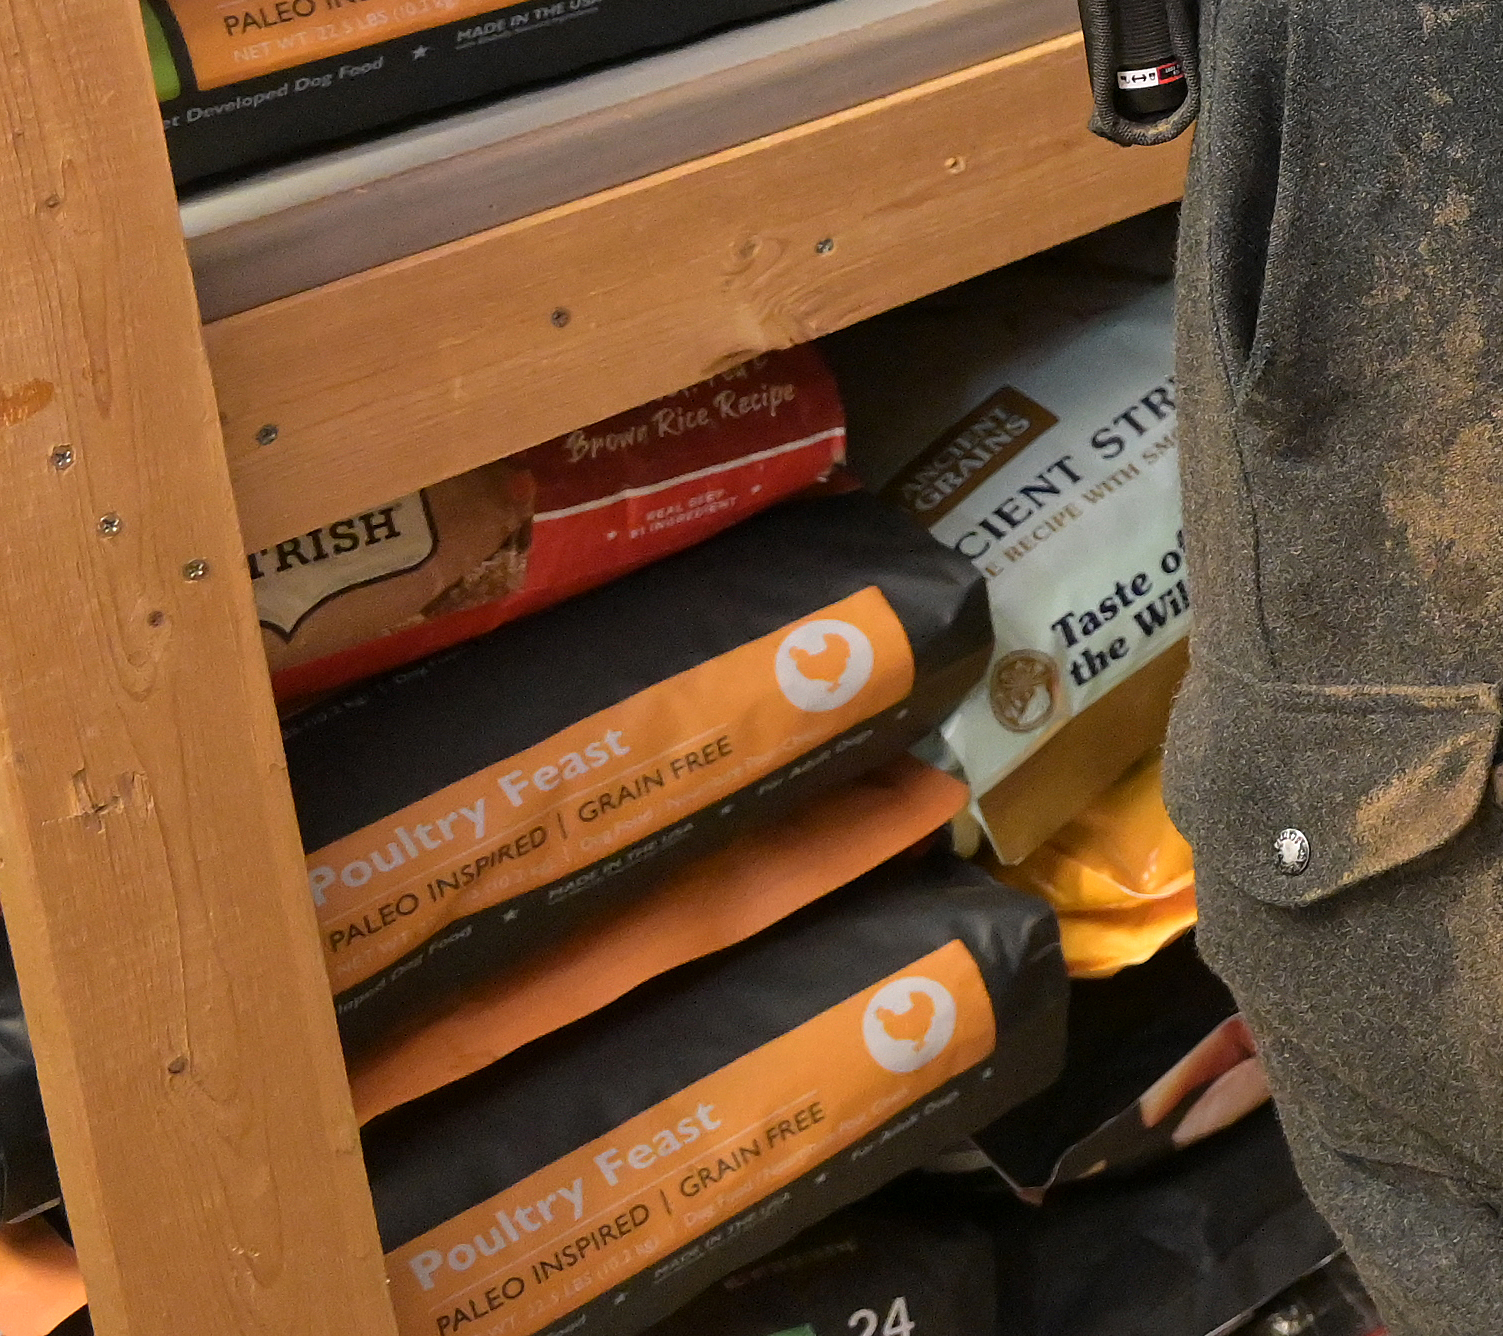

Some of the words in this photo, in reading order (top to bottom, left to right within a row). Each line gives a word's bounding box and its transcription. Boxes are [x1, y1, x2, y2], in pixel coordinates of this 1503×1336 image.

[185, 82, 289, 124] Developed
[293, 71, 334, 92] Dog
[338, 55, 385, 80] Food
[657, 409, 710, 439] Rice
[716, 379, 797, 422] Recipe
[1090, 374, 1177, 460] STR
[914, 413, 1032, 512] GRAINS
[1002, 503, 1084, 563] RECIPE
[1081, 462, 1141, 505] WITH
[1050, 569, 1154, 649] Taste
[1068, 636, 1130, 687] the
[307, 797, 486, 908] Poultry
[496, 728, 632, 808] Feast
[326, 892, 421, 954] PALEO
[426, 824, 548, 903] INSPIRED
[577, 768, 665, 825] GRAIN
[668, 734, 734, 780] FREE
[408, 1177, 584, 1292] Poultry
[592, 1101, 723, 1187] Feast
[435, 1275, 526, 1336] PALEO
[531, 1203, 651, 1286] INSPIRED
[679, 1139, 761, 1199] GRAIN
[765, 1101, 826, 1149] FREE
